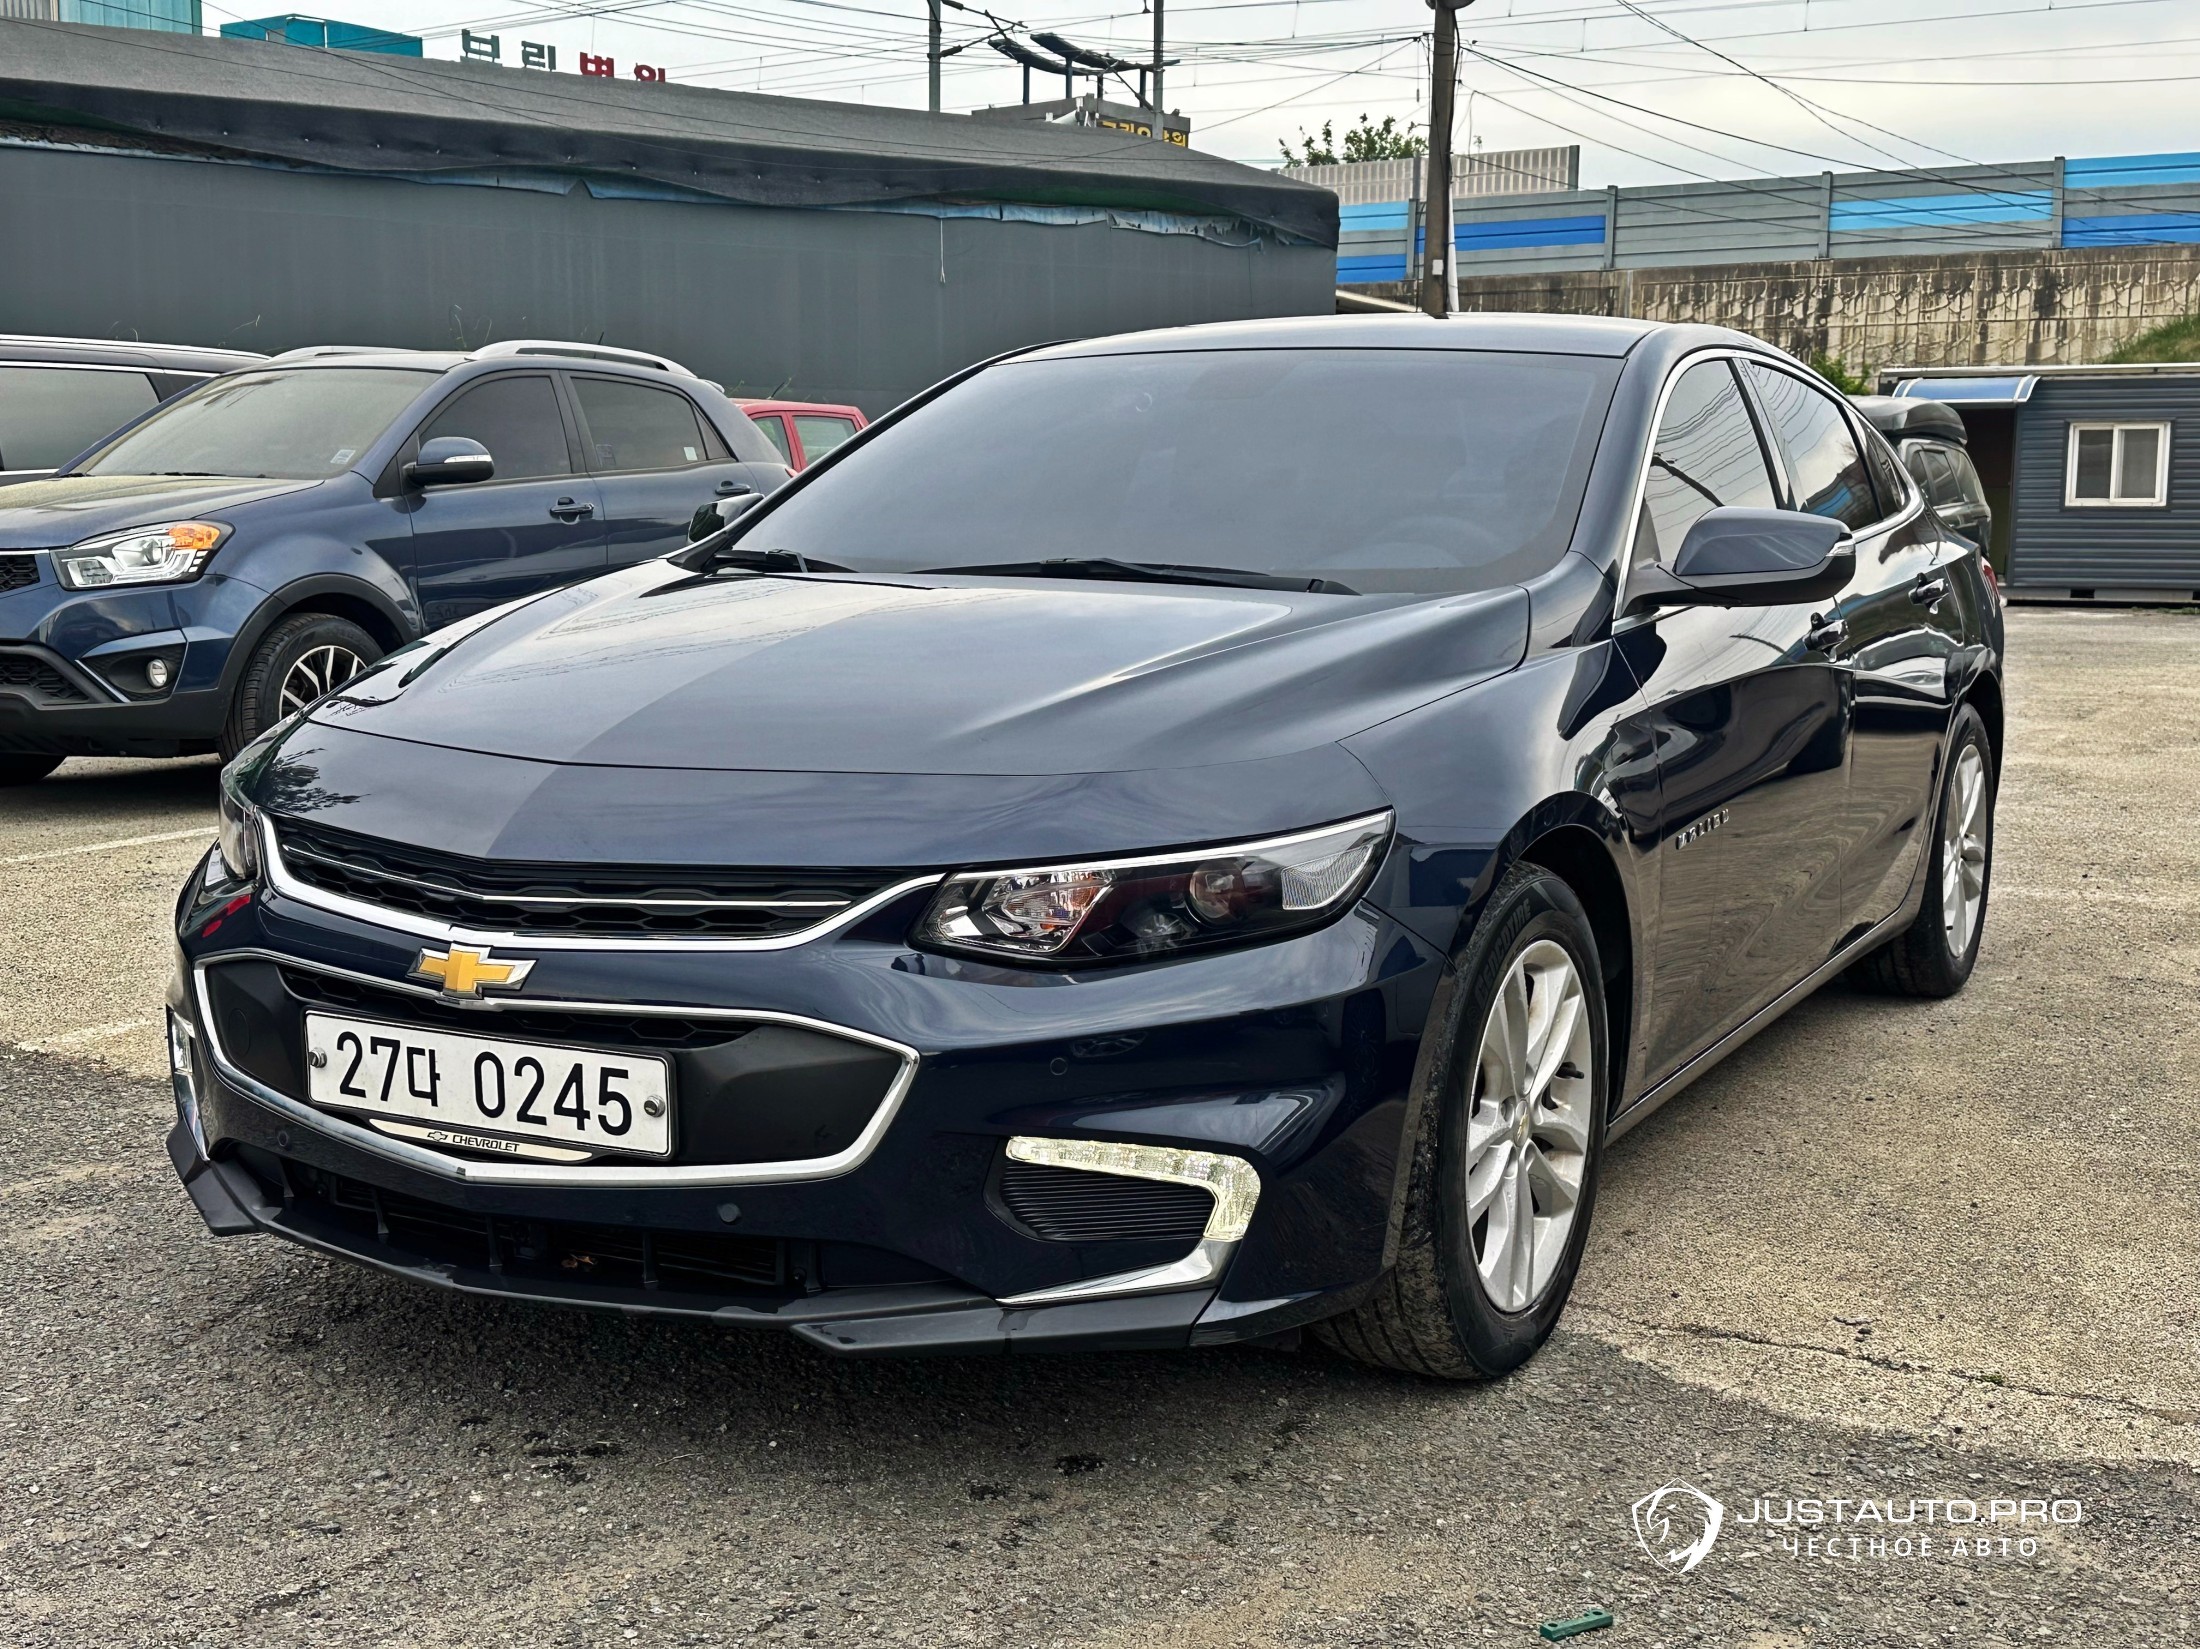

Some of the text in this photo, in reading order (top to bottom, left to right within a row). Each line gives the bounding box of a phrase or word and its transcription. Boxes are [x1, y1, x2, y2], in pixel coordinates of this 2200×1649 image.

[336, 1031, 632, 1136] 27다 0245
[452, 1134, 520, 1153] CHEVROLET
